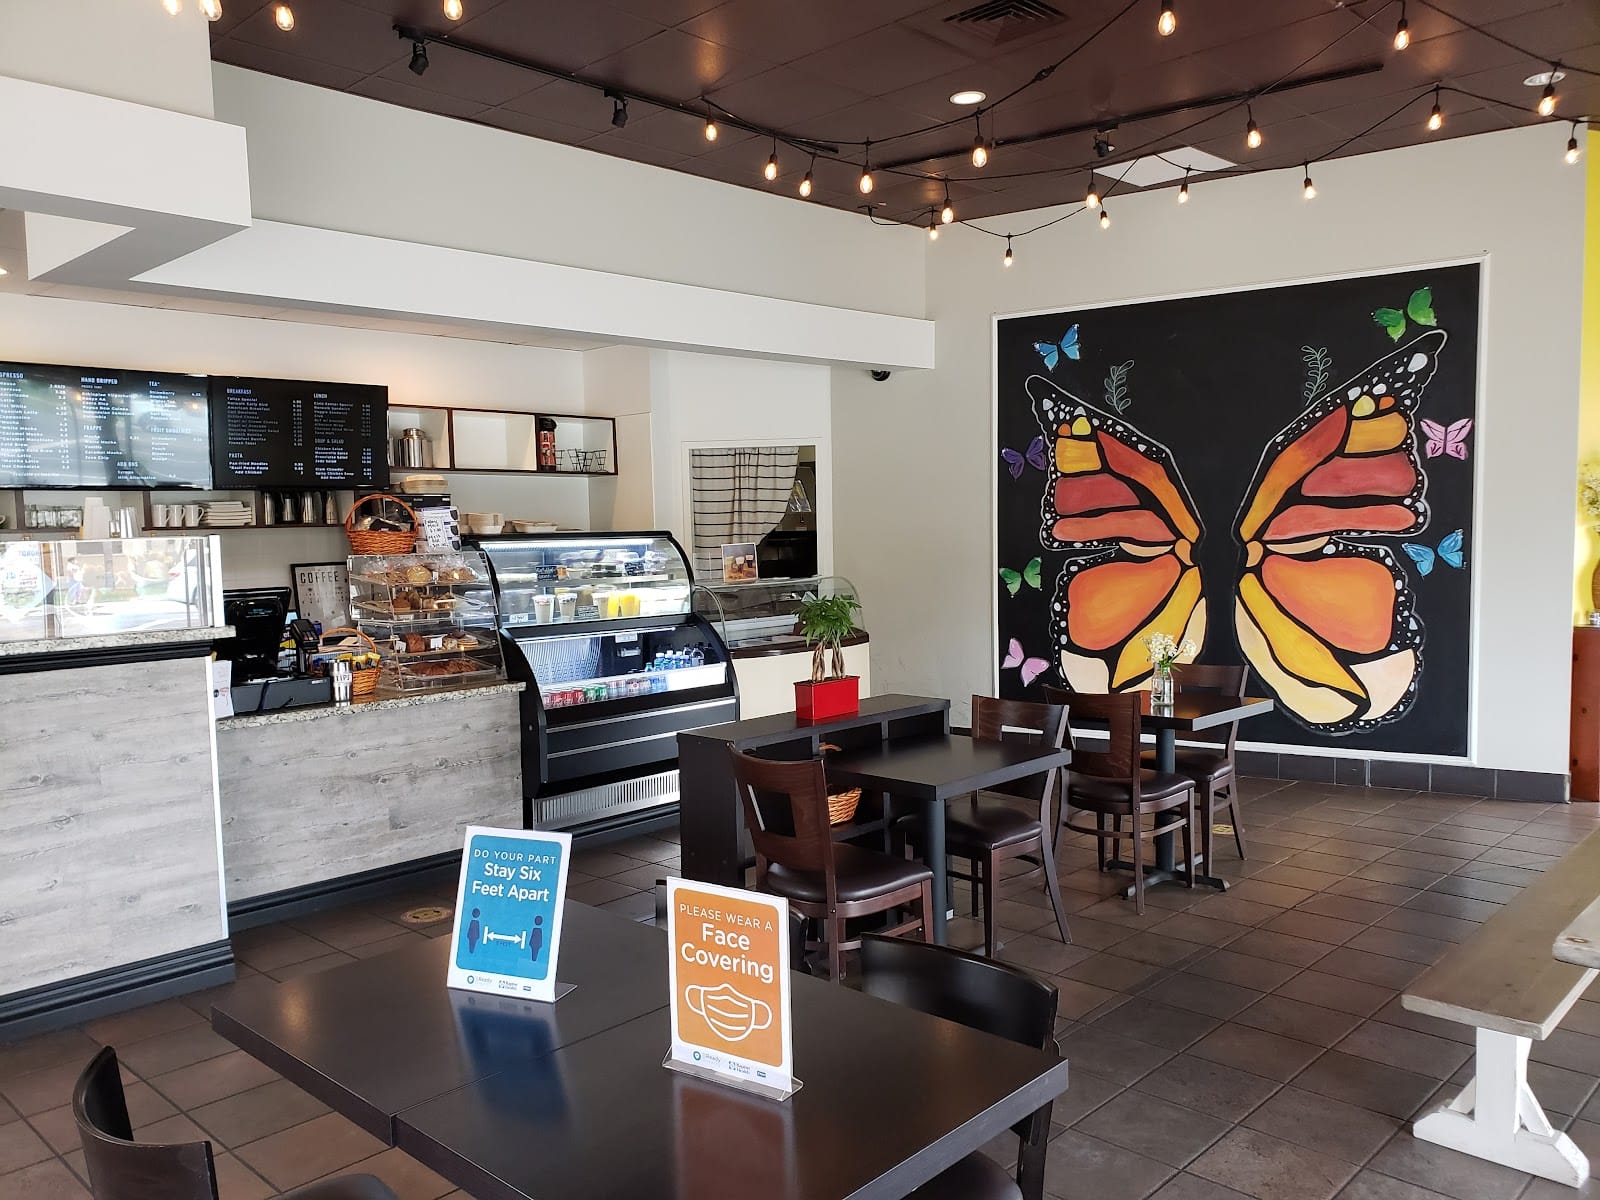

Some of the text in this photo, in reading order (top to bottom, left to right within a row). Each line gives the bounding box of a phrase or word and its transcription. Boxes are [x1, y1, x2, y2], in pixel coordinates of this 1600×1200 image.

[300, 571, 339, 584] COFFEE
[474, 848, 556, 865] DO YOUR PART
[484, 862, 542, 882] Stay Six
[471, 880, 550, 902] Feet Apart
[679, 903, 773, 933] PLEASE WEAR A
[702, 922, 751, 951] Face
[681, 942, 774, 984] Covering
